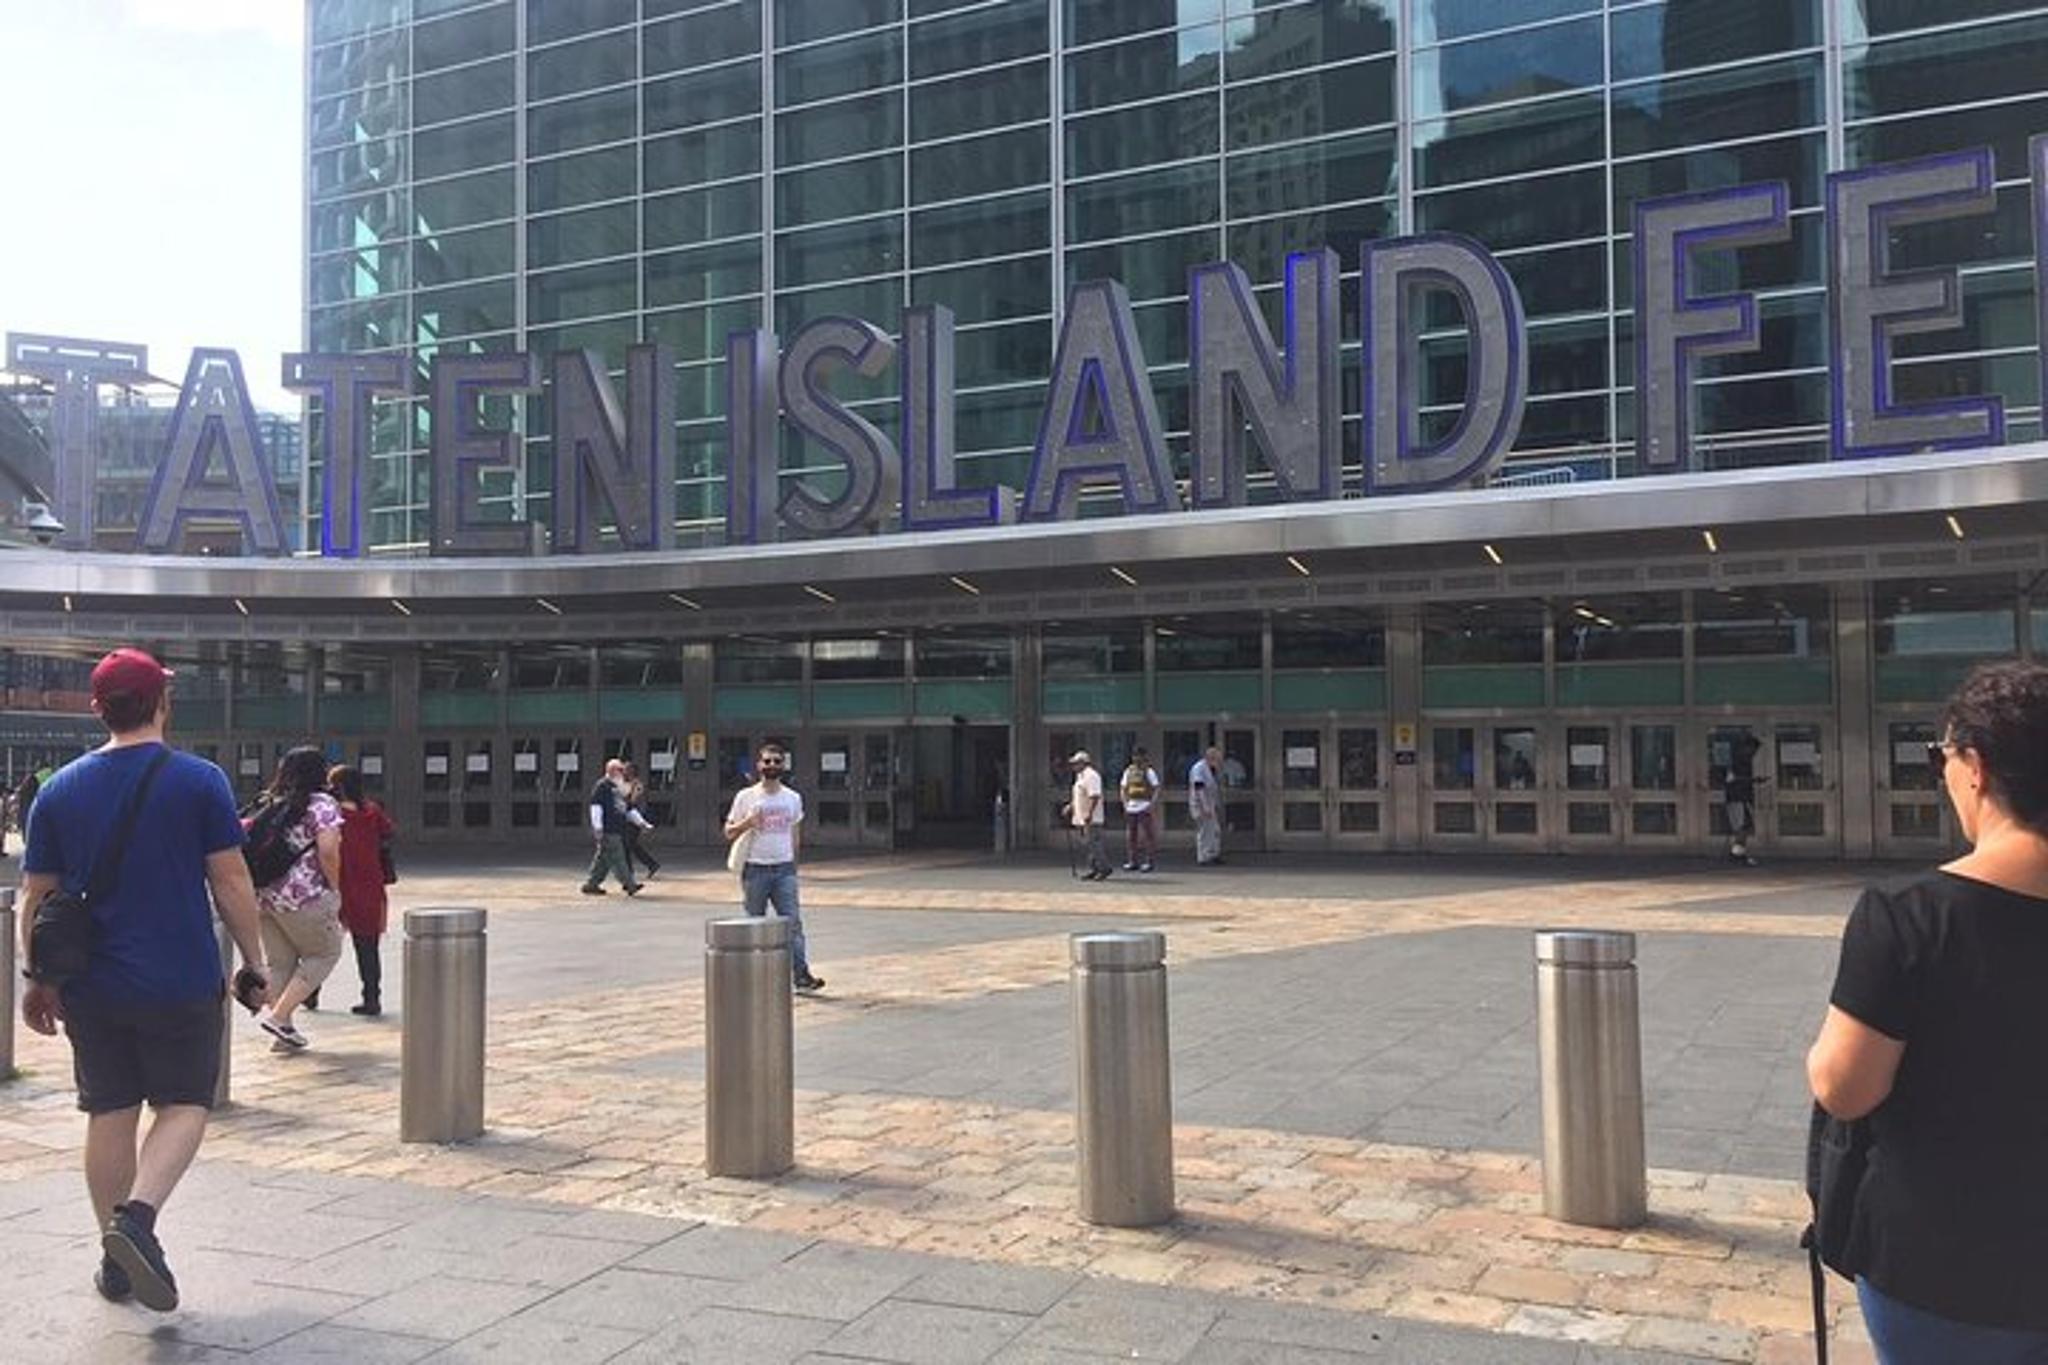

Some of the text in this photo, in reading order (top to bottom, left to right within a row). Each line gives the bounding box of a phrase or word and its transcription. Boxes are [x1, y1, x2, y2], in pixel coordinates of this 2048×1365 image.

[6, 134, 2048, 559] TATEN ISLAND FE
